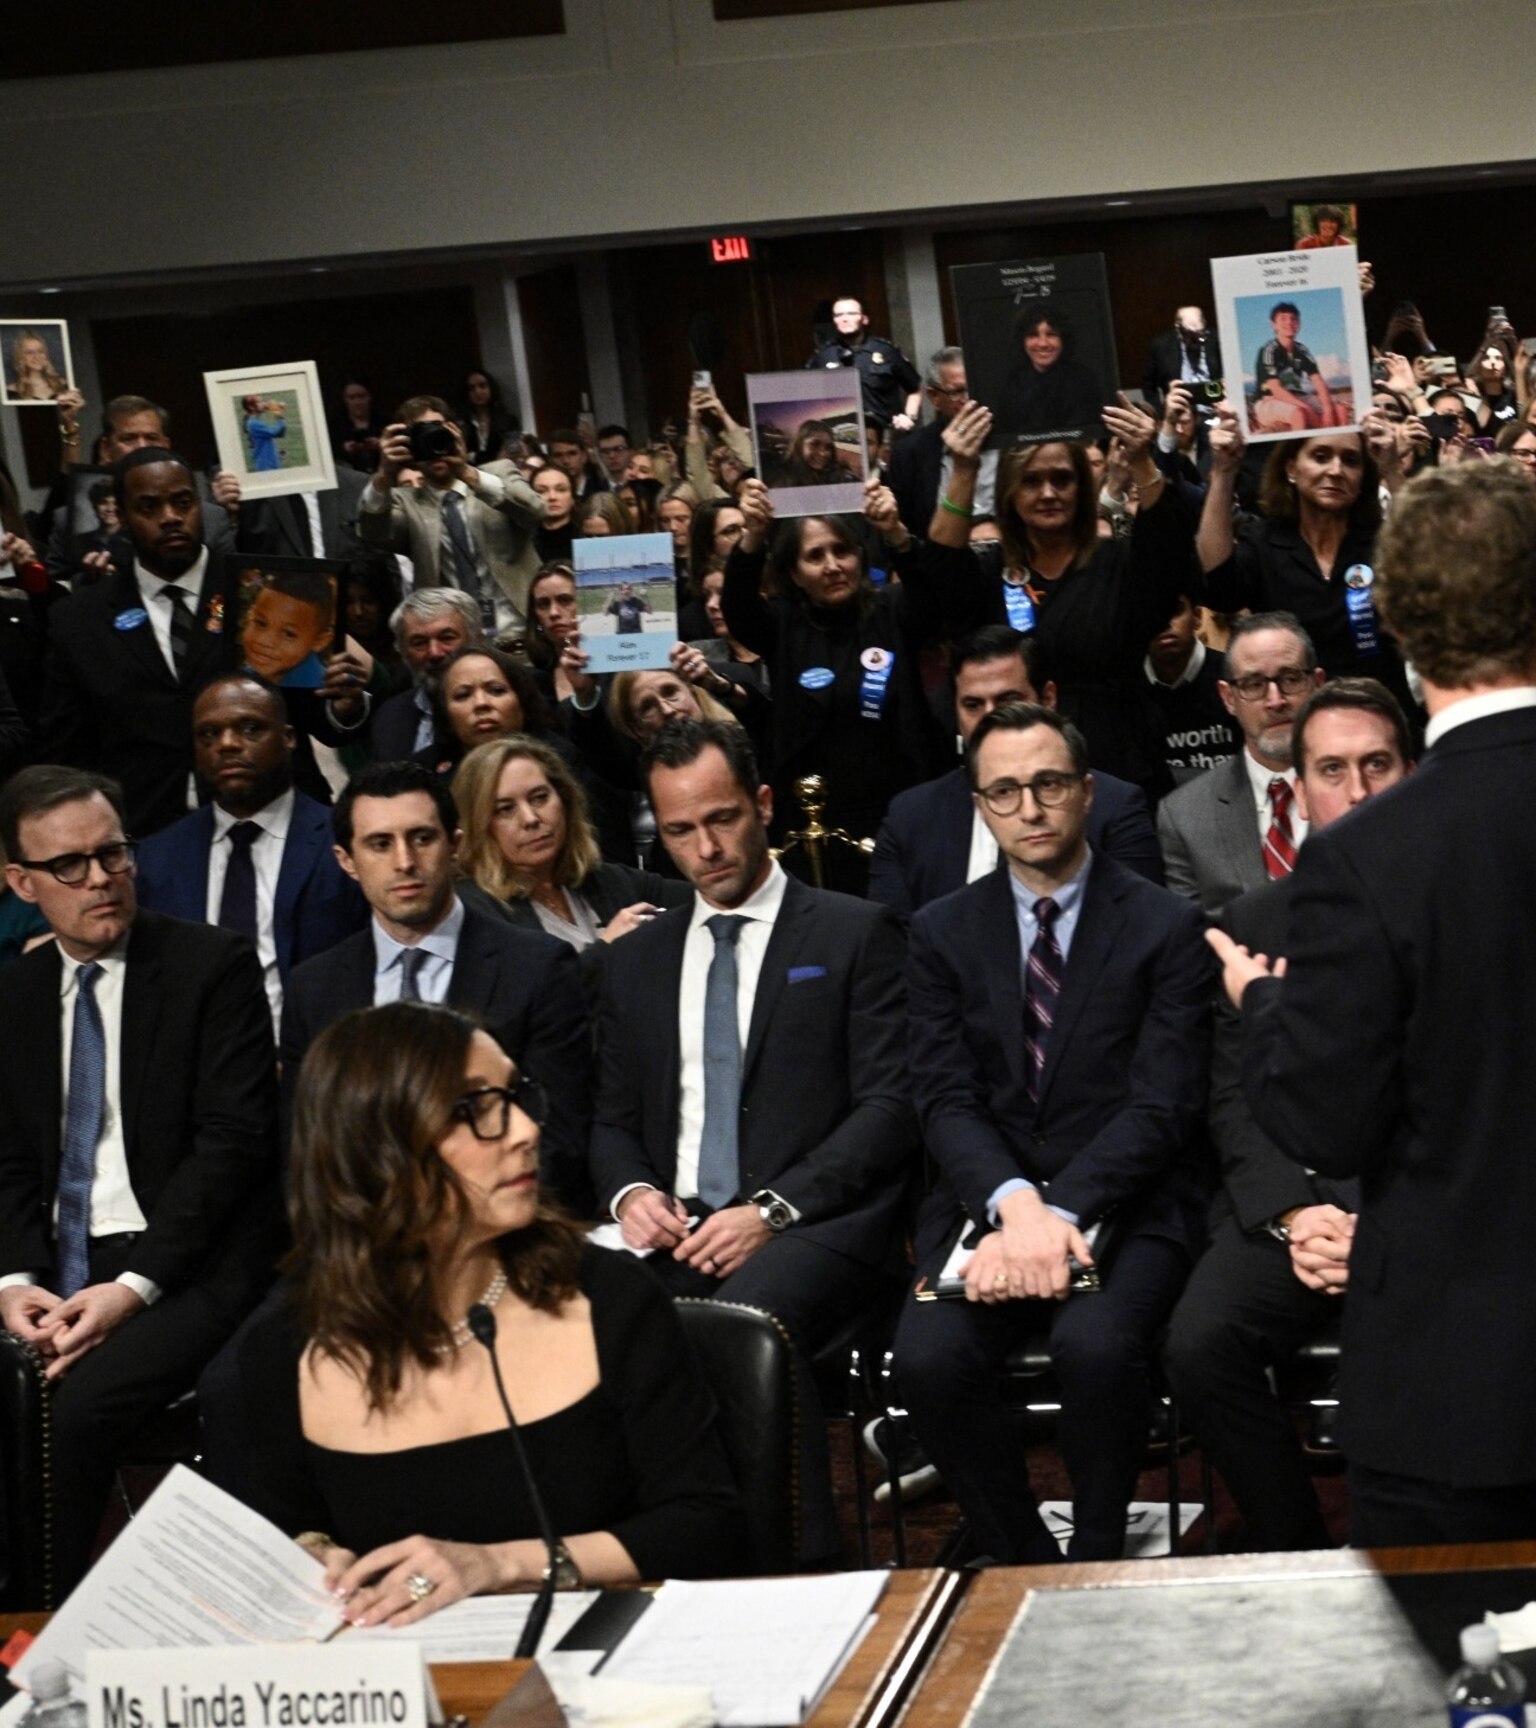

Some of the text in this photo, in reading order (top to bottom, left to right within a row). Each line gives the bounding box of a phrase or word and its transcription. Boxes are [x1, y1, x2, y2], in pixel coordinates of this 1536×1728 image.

[711, 237, 749, 261] EXIT
[1166, 724, 1233, 748] worth
[102, 1678, 408, 1728] Ms. Linda Yaccarino
